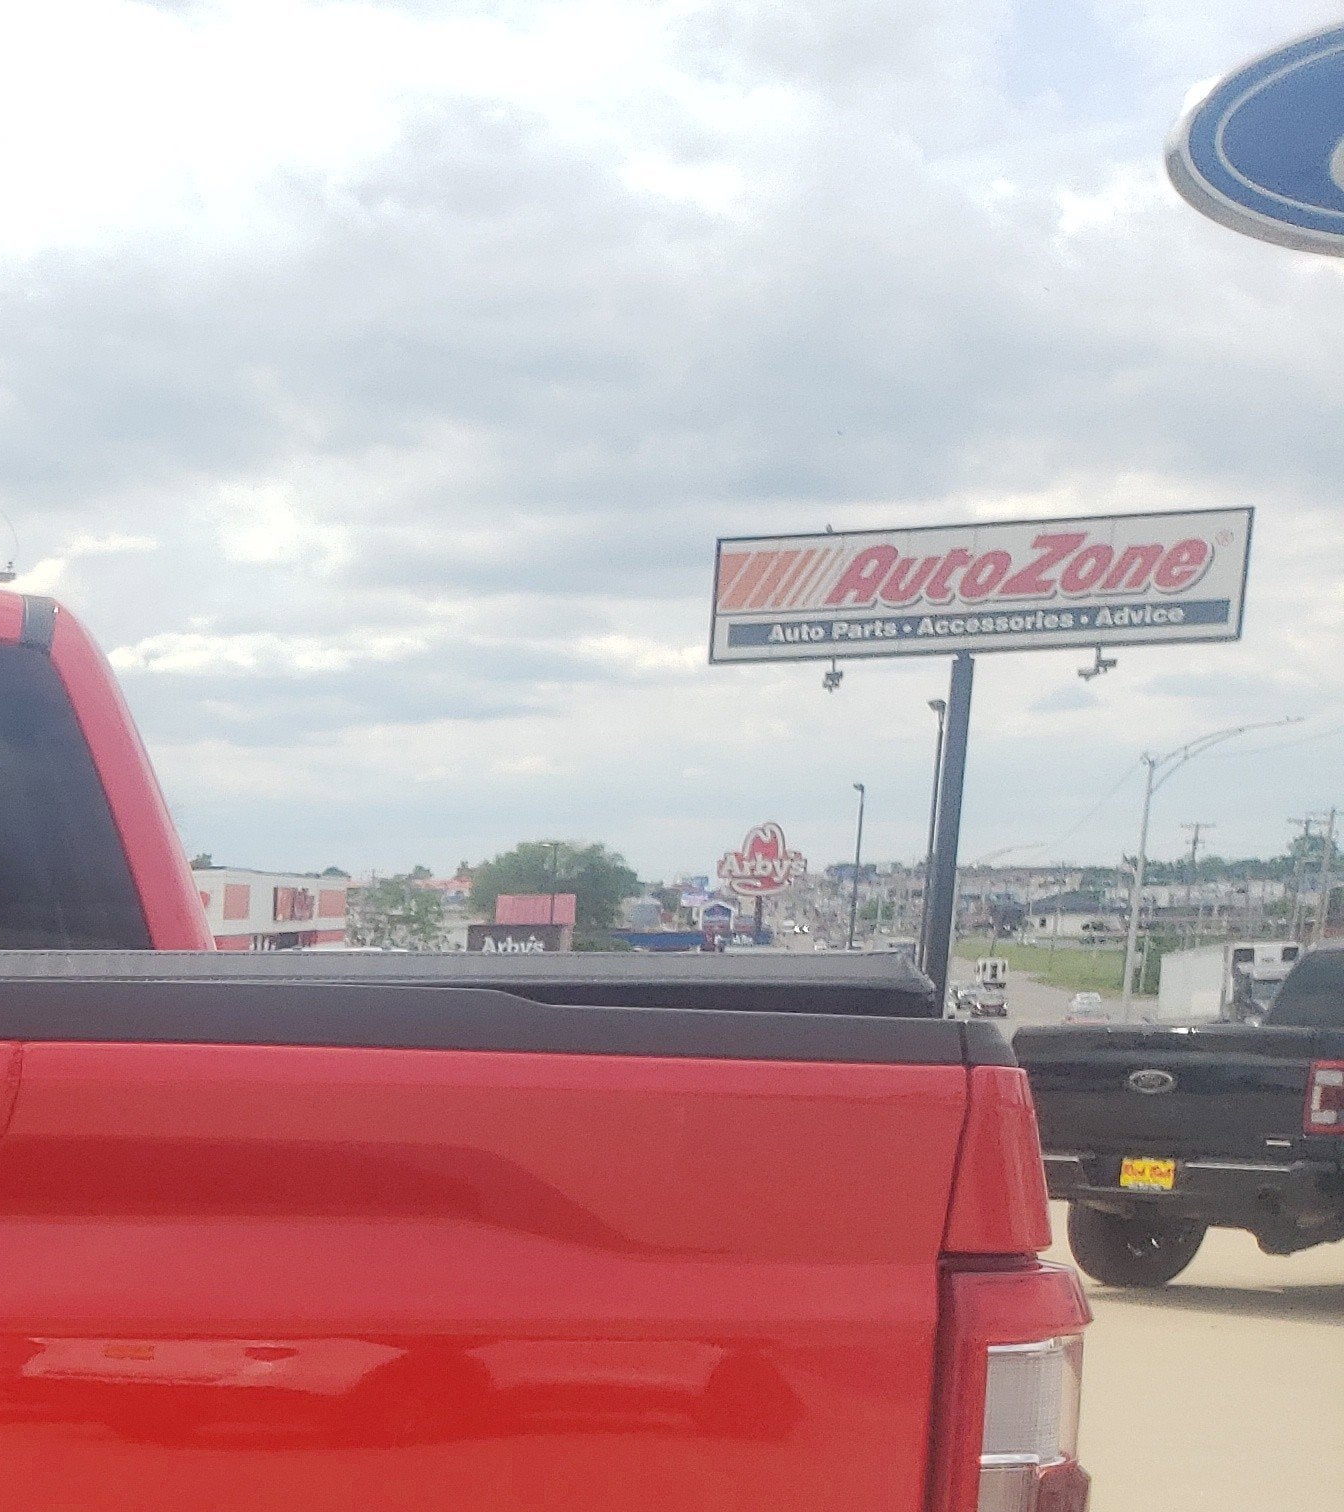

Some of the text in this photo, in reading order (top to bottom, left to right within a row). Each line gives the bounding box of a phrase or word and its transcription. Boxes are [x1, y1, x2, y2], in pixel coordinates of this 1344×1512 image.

[822, 530, 1211, 607] AutoZone
[768, 603, 1185, 644] Auto Parts Accessories Advice
[721, 852, 807, 885] Arby's
